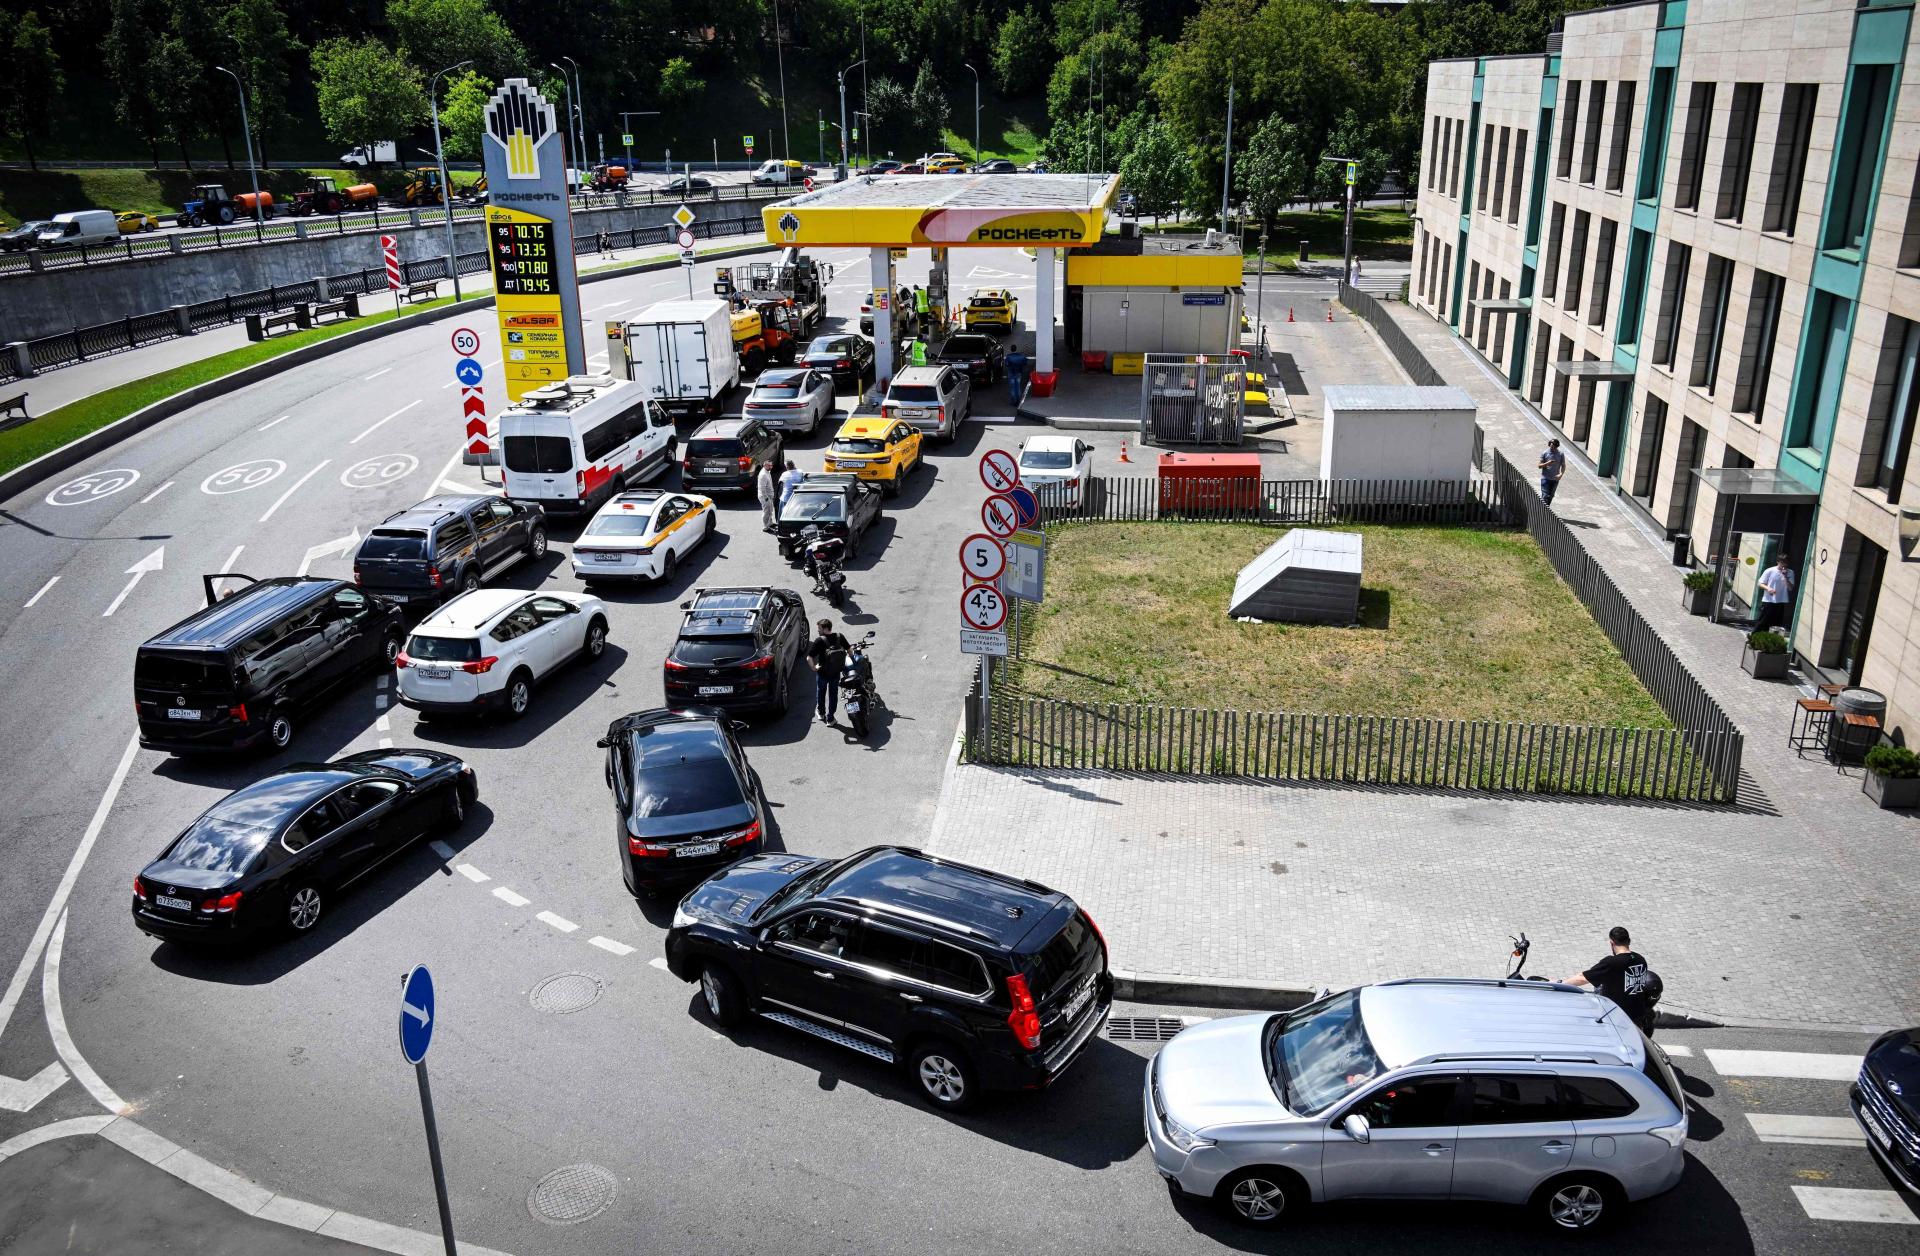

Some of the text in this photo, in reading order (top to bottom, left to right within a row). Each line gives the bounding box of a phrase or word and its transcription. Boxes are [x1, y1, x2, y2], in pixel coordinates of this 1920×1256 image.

[494, 193, 560, 201] РОСНЕФТЬ
[498, 225, 544, 238] 95 70.75
[978, 228, 1082, 240] РОСНЕФТЬ
[516, 243, 546, 257] 73.35
[518, 261, 548, 274] 97.80
[504, 278, 550, 292] ДТ 79.45
[508, 317, 555, 325] PULSAR
[457, 336, 474, 348] 50
[214, 468, 274, 485] 50
[351, 460, 410, 480] 50
[61, 477, 127, 497] 50
[976, 548, 988, 568] 5
[1820, 548, 1828, 565] 9
[970, 593, 997, 611] 4,5
